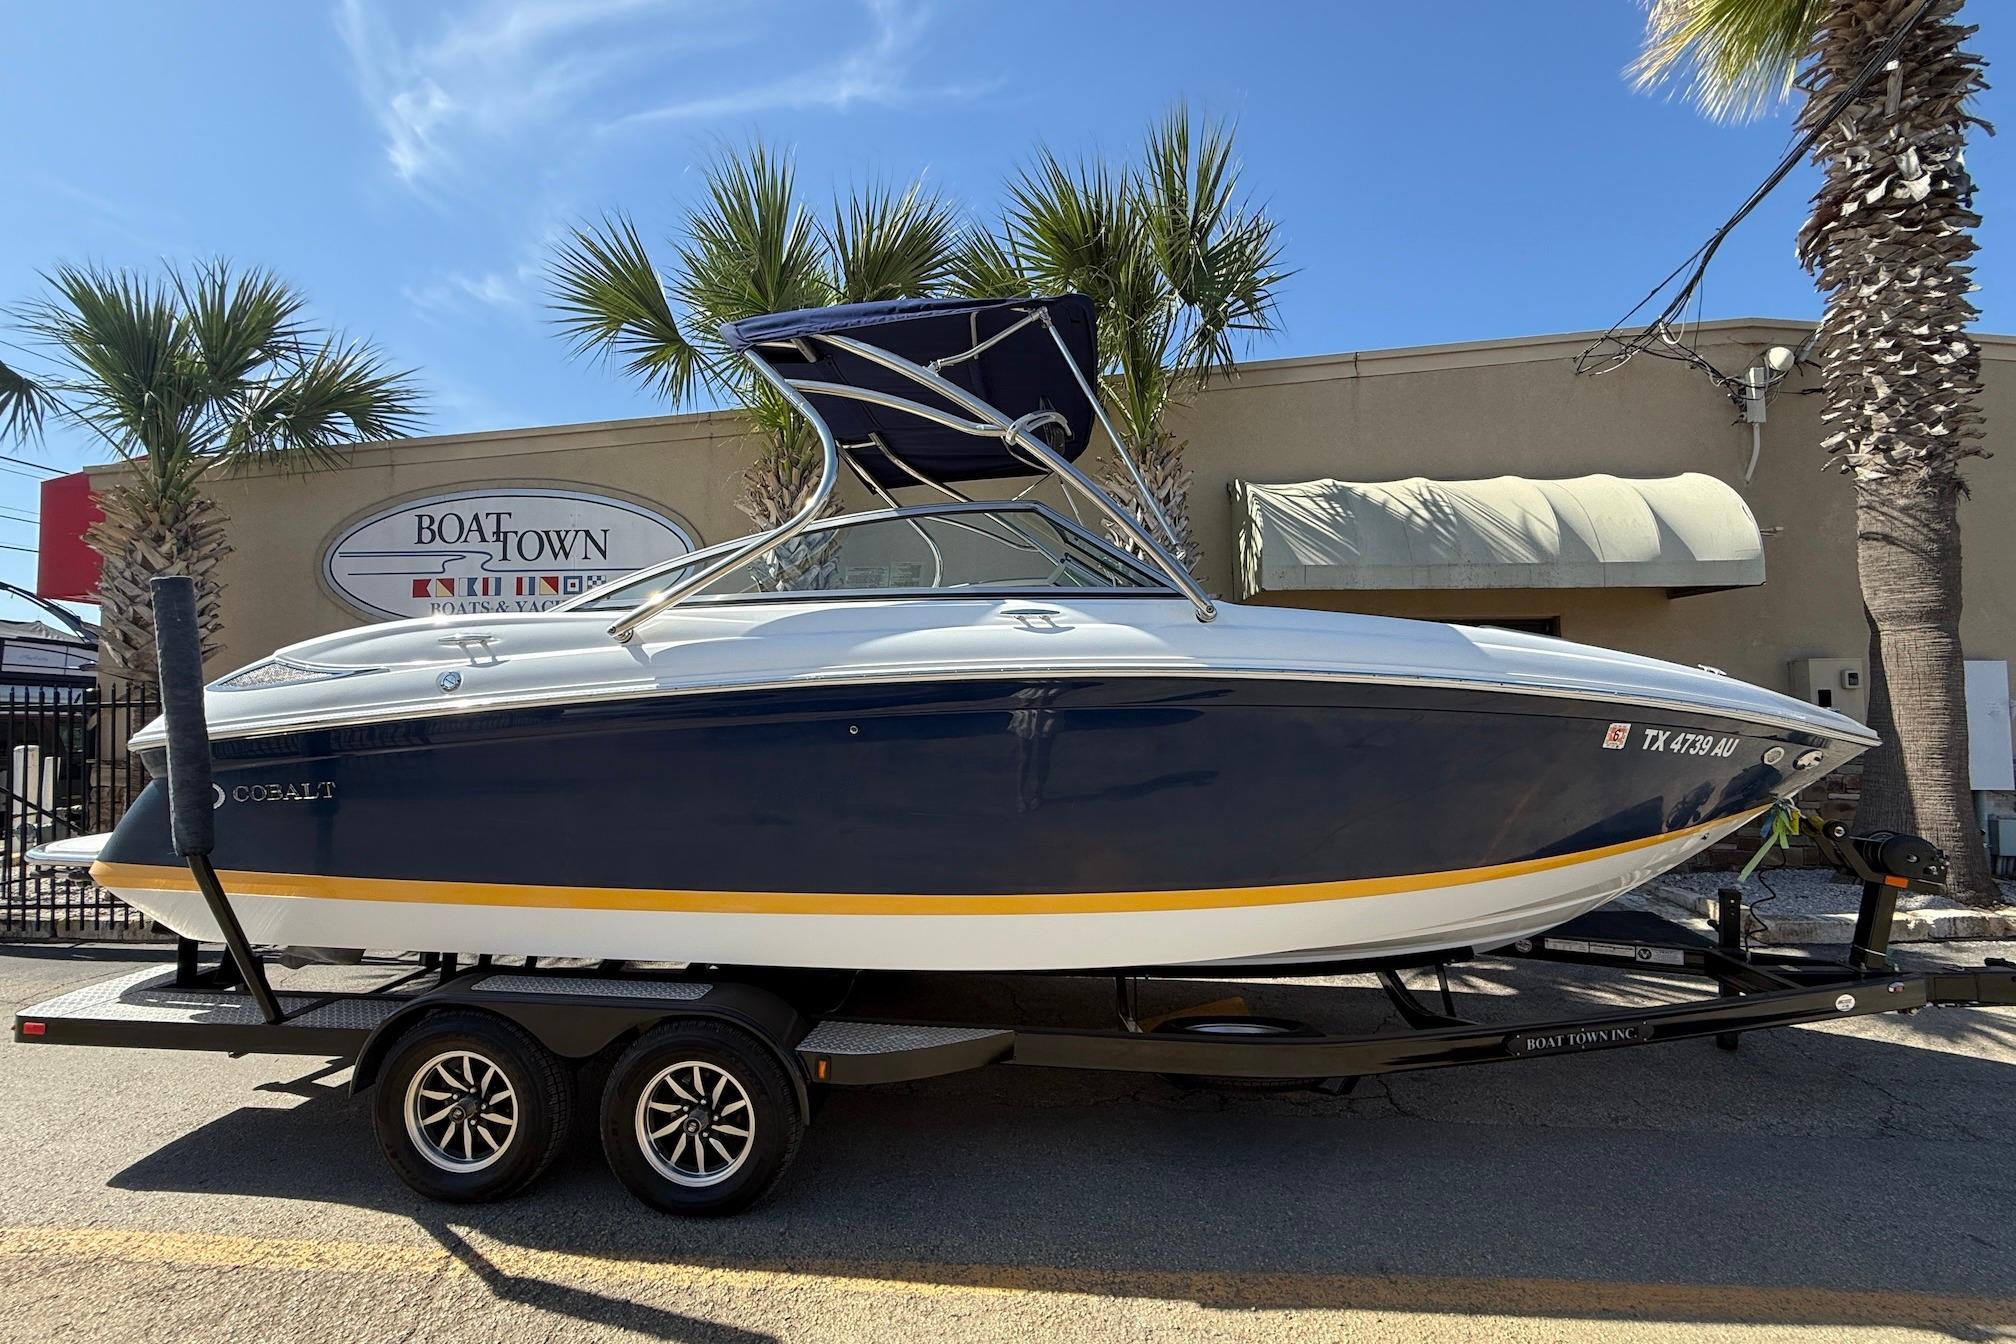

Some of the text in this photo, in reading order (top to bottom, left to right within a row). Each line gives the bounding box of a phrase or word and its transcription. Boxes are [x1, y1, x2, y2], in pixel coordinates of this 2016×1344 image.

[414, 512, 611, 562] BOAT TOWN
[430, 601, 491, 616] BOATS
[495, 601, 509, 613] &
[1642, 728, 1740, 758] TX 4739 AU
[232, 781, 337, 802] COBALT
[1527, 1027, 1638, 1051] BOAT TOWN INC.
